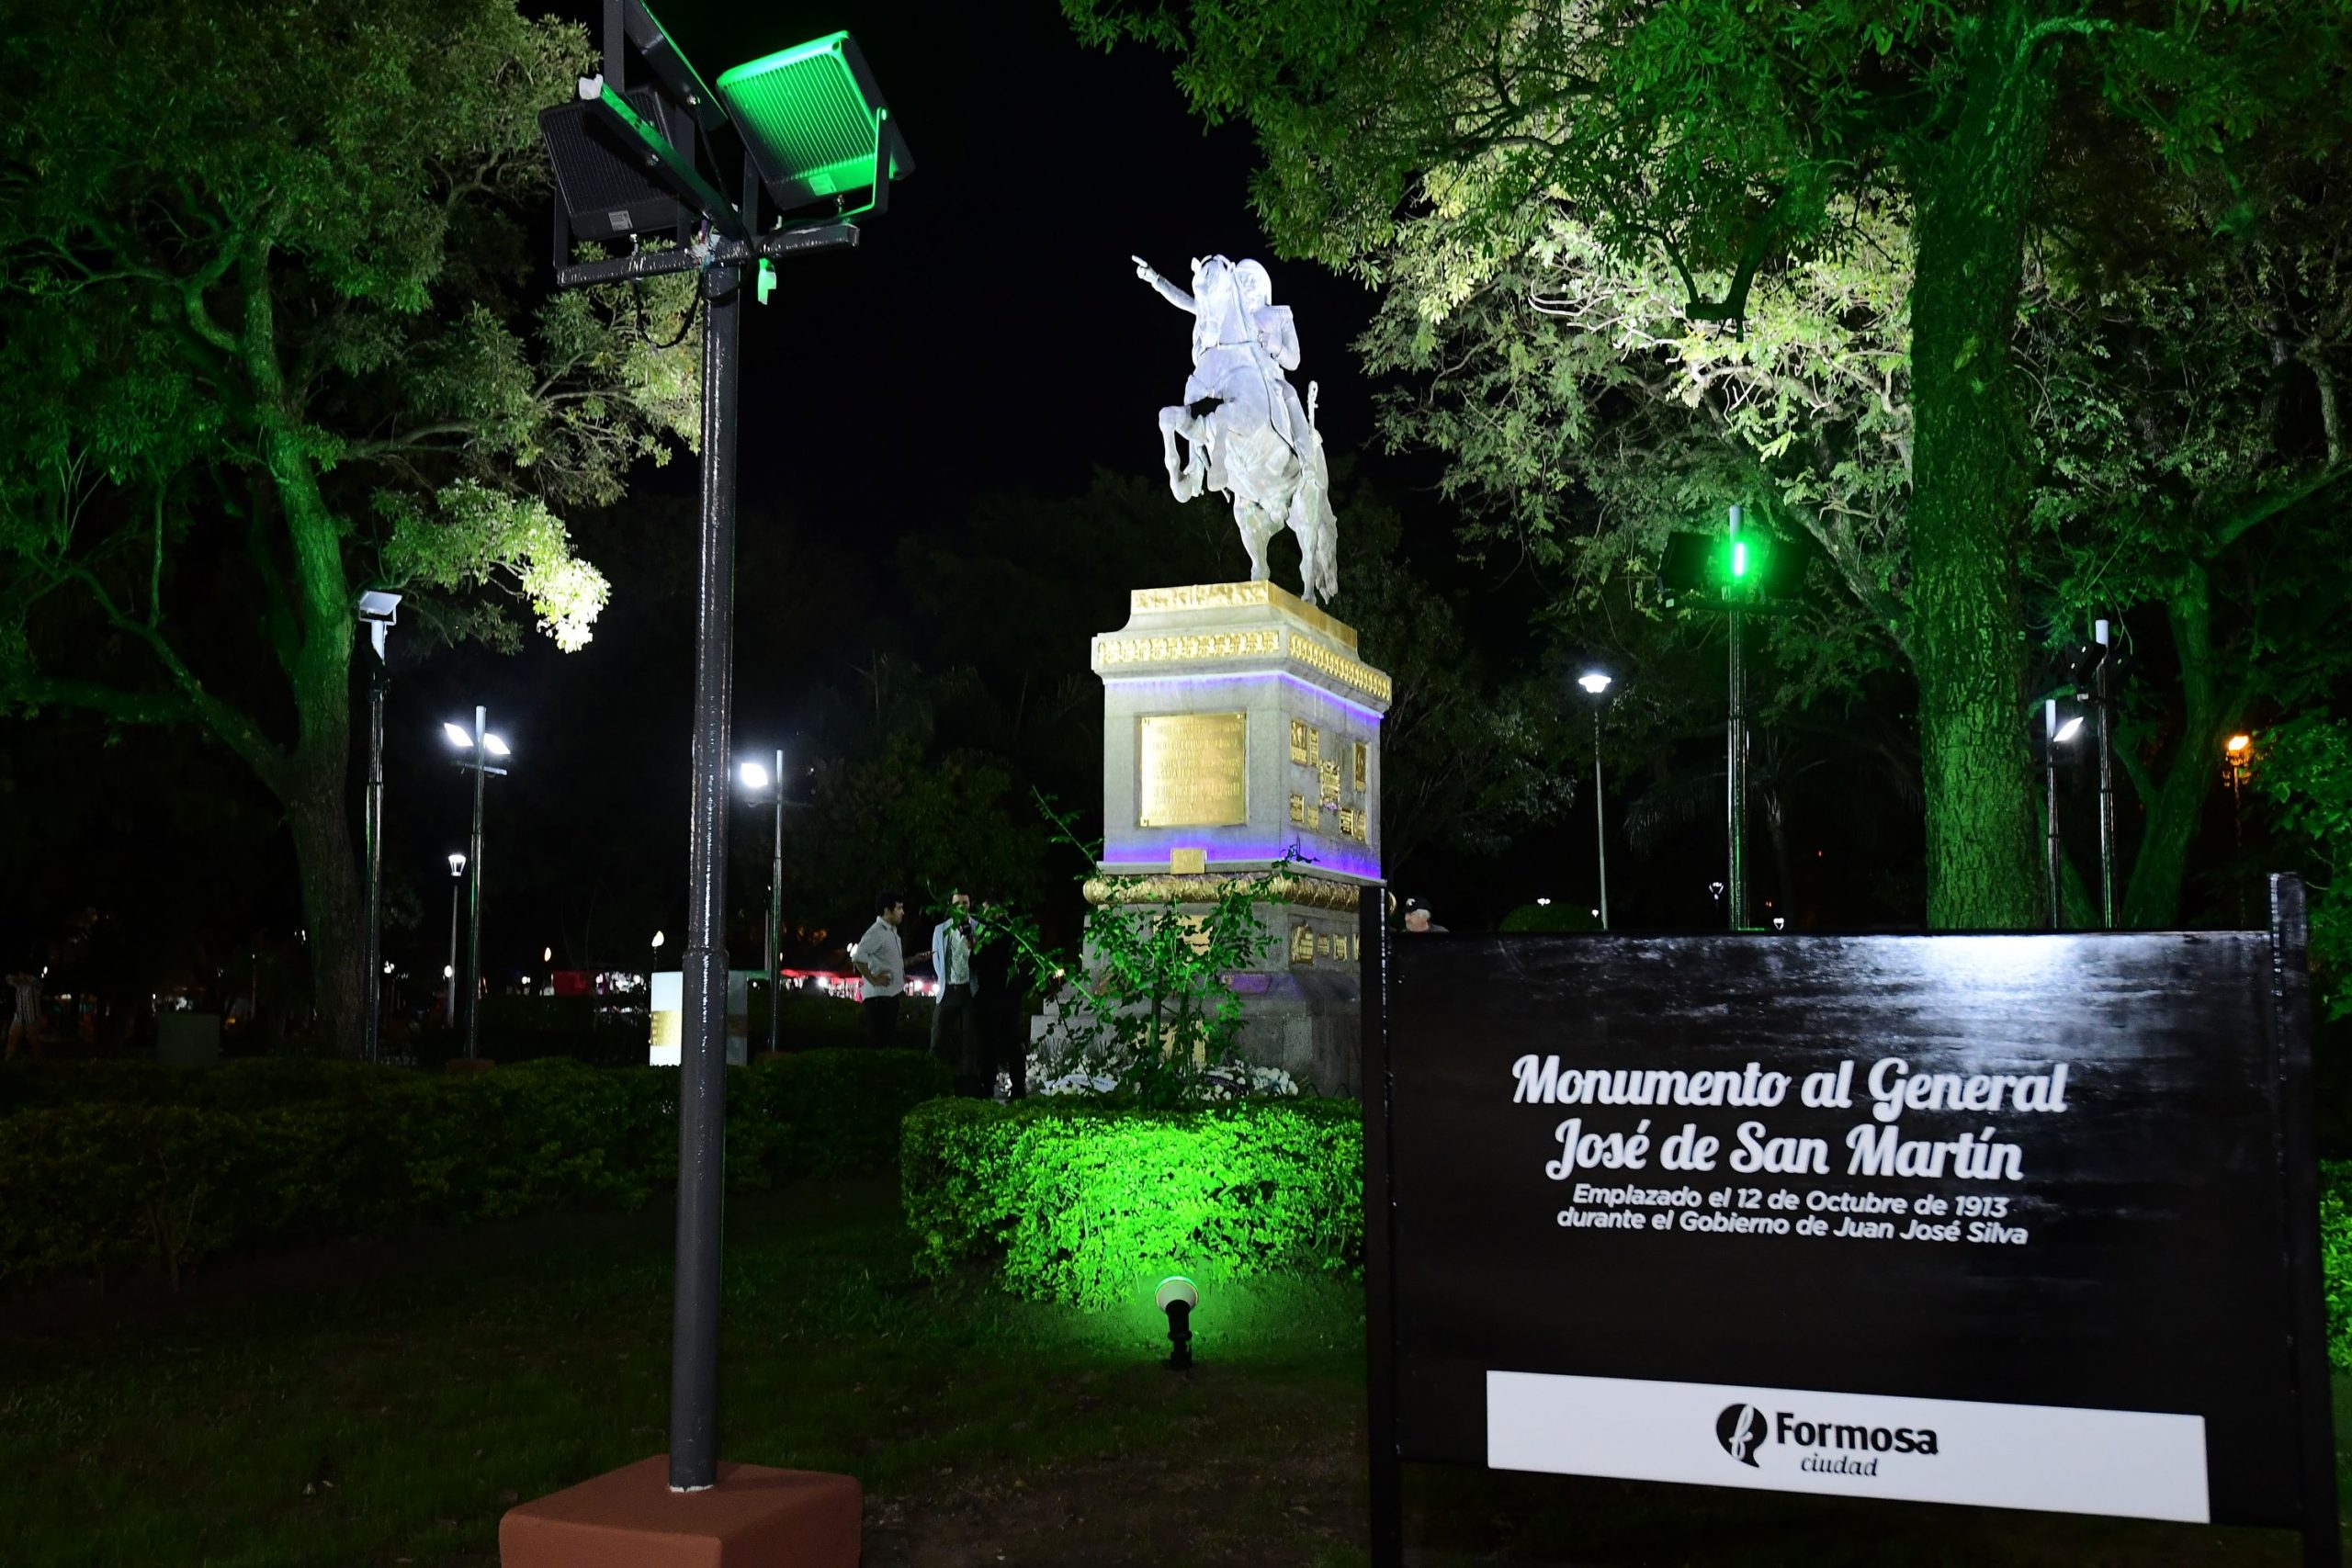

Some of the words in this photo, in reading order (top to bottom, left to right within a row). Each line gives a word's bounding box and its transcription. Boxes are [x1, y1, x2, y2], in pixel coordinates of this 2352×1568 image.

[1511, 1054, 1792, 1108] Monumento
[1801, 1060, 1855, 1109] al
[1868, 1056, 2069, 1122] General
[1545, 1118, 1651, 1180] José
[1660, 1122, 1720, 1171] de
[1729, 1121, 1830, 1175] San
[1846, 1123, 2024, 1181] Martín
[1572, 1182, 1702, 1208] Emplazado
[1708, 1187, 1733, 1208] el
[1737, 1188, 1763, 1209] 12
[1767, 1189, 1801, 1211] de
[1805, 1190, 1908, 1214] Octubre
[1914, 1193, 1948, 1216] de
[1955, 1195, 2010, 1218] 1913
[1556, 1206, 1647, 1229] durante
[1651, 1209, 1675, 1230] el
[1679, 1210, 1791, 1235] Gobierno
[1795, 1214, 1829, 1236] de
[1833, 1216, 1894, 1239] Juan
[1899, 1219, 1962, 1242] José
[1966, 1221, 2029, 1245] Silva
[1776, 1411, 1939, 1456] Formosa
[1801, 1453, 1879, 1477] ciudad
